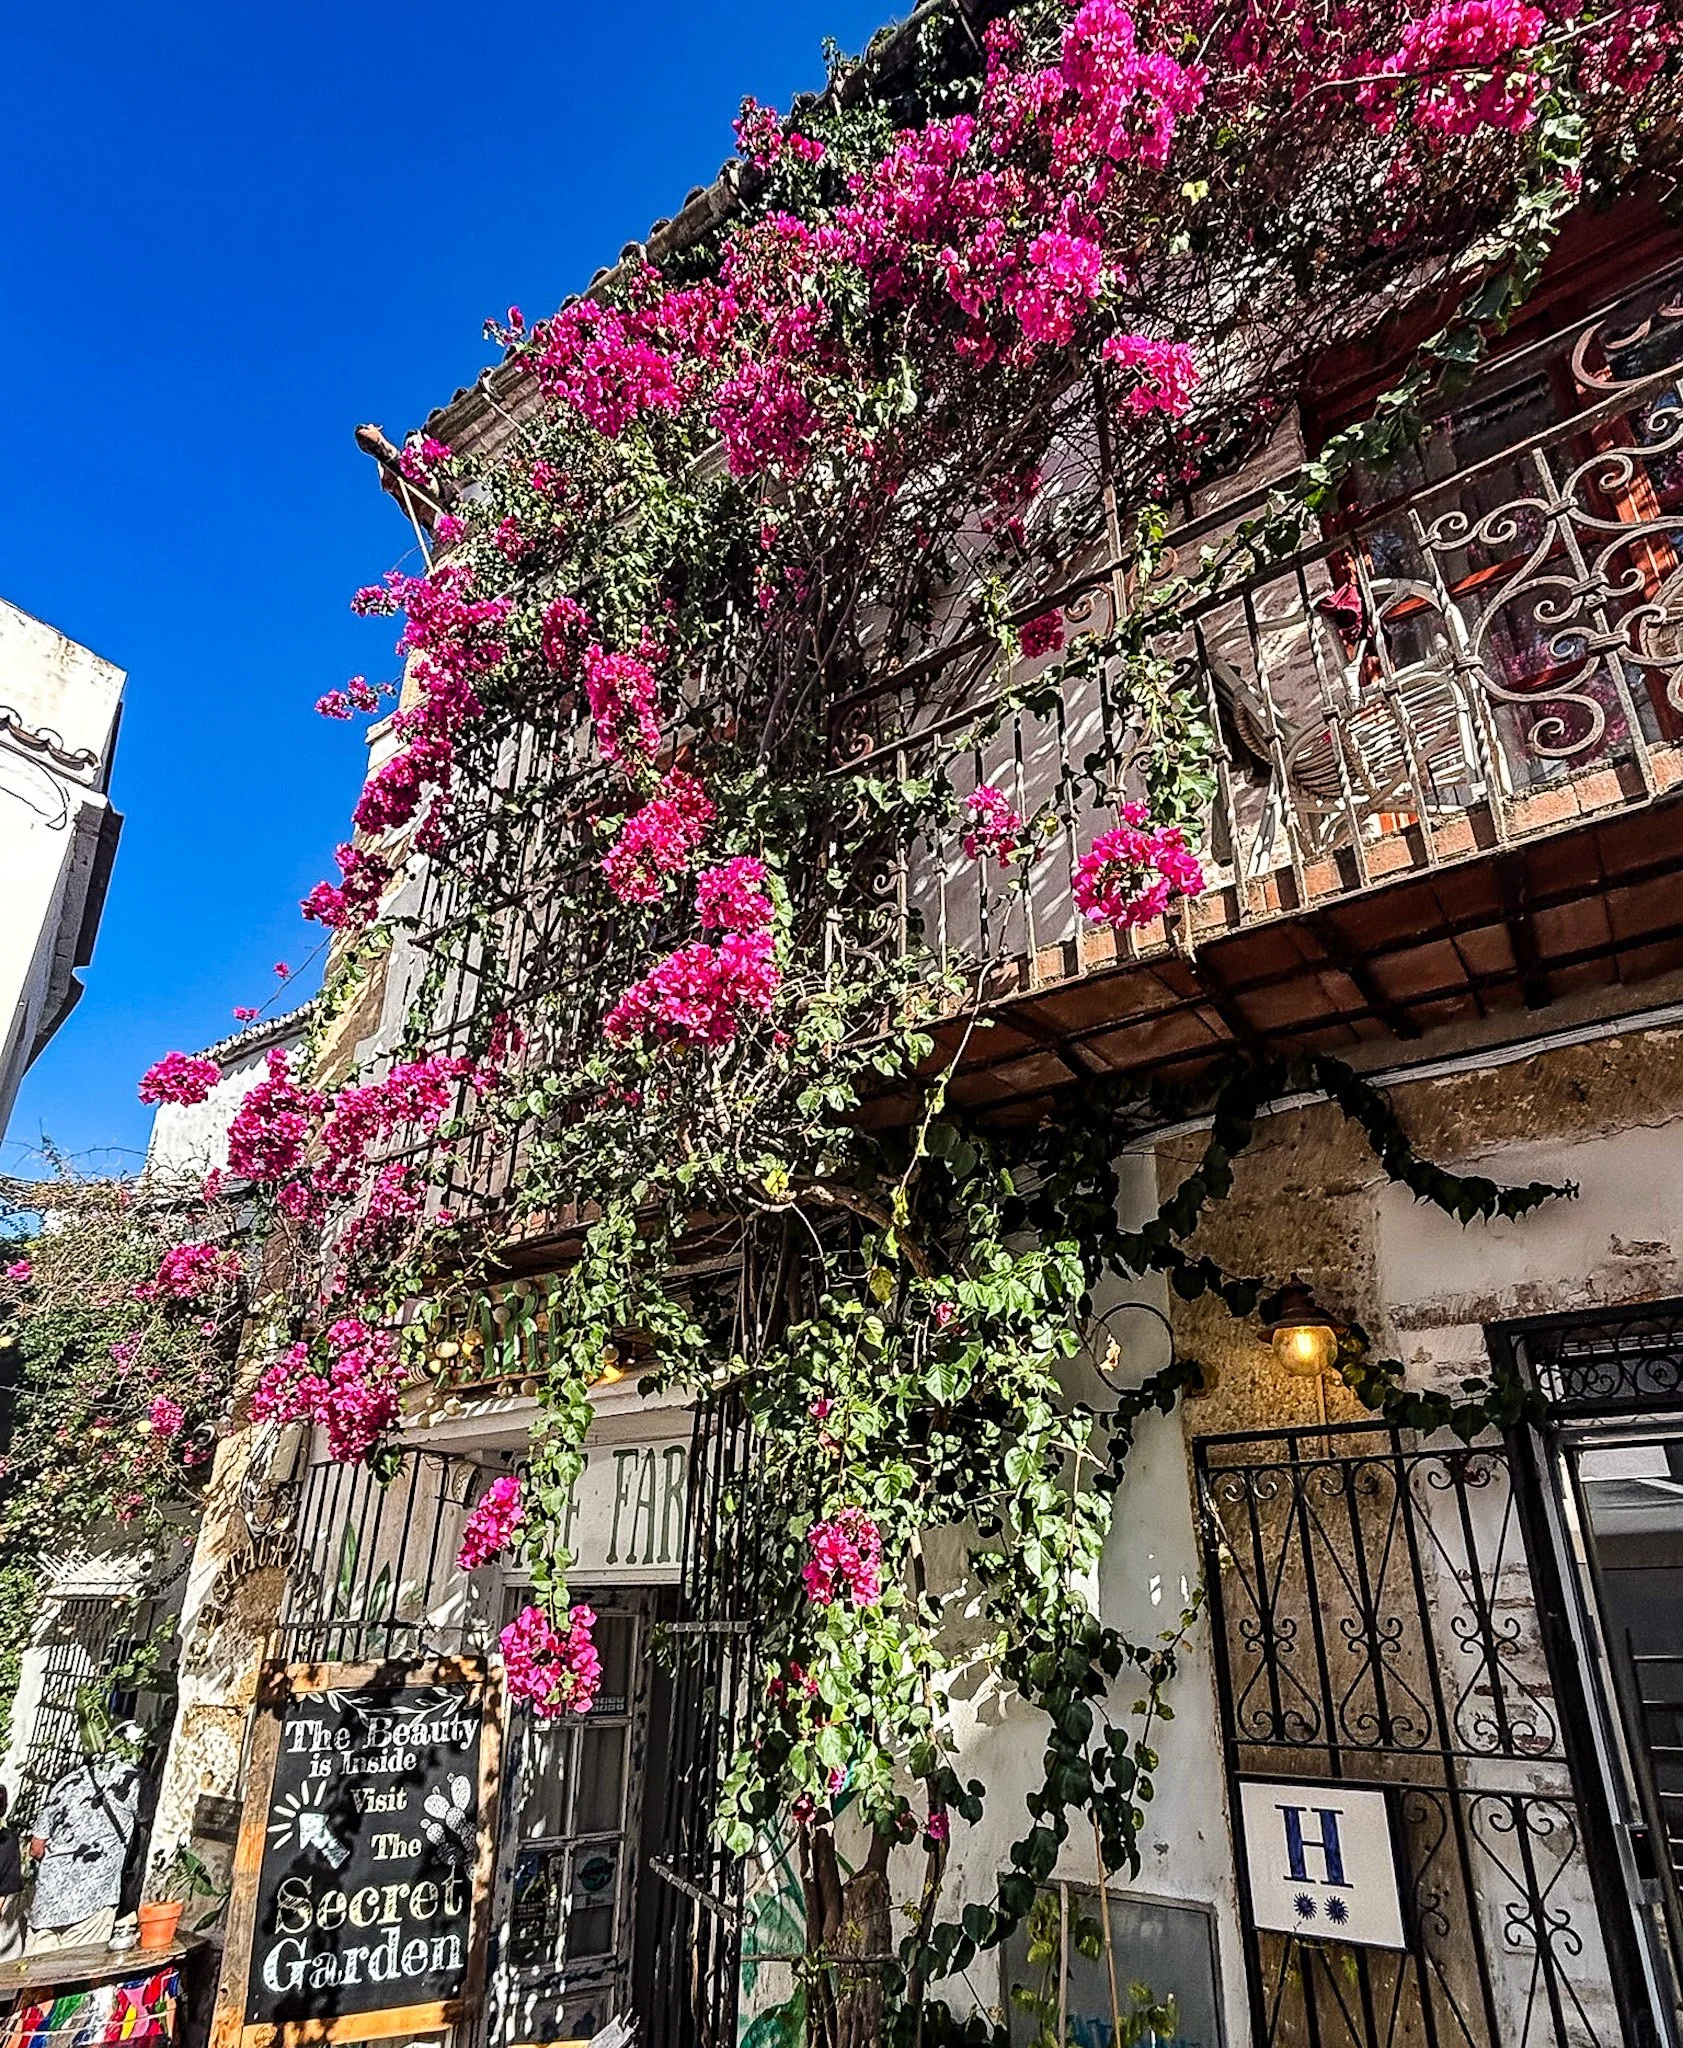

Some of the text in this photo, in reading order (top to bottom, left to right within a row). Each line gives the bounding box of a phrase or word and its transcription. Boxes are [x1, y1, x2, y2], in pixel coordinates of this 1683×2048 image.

[285, 1712, 480, 1753] The Beauty
[308, 1746, 417, 1778] is Inside
[350, 1786, 408, 1814] Visit
[370, 1833, 423, 1861] The
[1274, 1804, 1354, 1889] H
[274, 1864, 464, 1935] Secret
[263, 1925, 465, 1992] Garden
